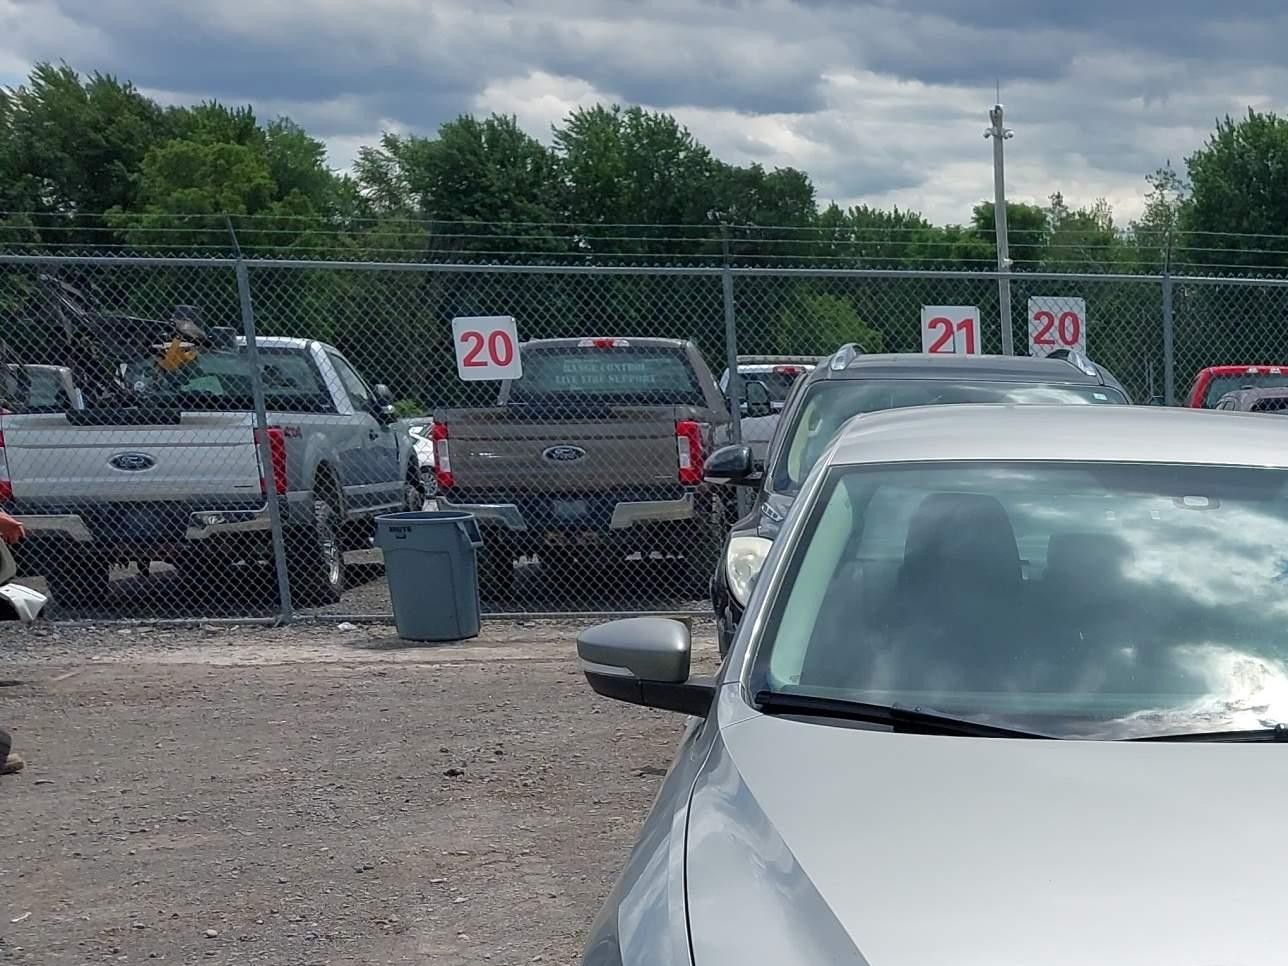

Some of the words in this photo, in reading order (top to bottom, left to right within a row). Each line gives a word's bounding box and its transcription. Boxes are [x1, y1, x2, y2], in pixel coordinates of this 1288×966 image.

[927, 317, 976, 354] 21
[1033, 311, 1081, 346] 20
[460, 330, 513, 367] 20
